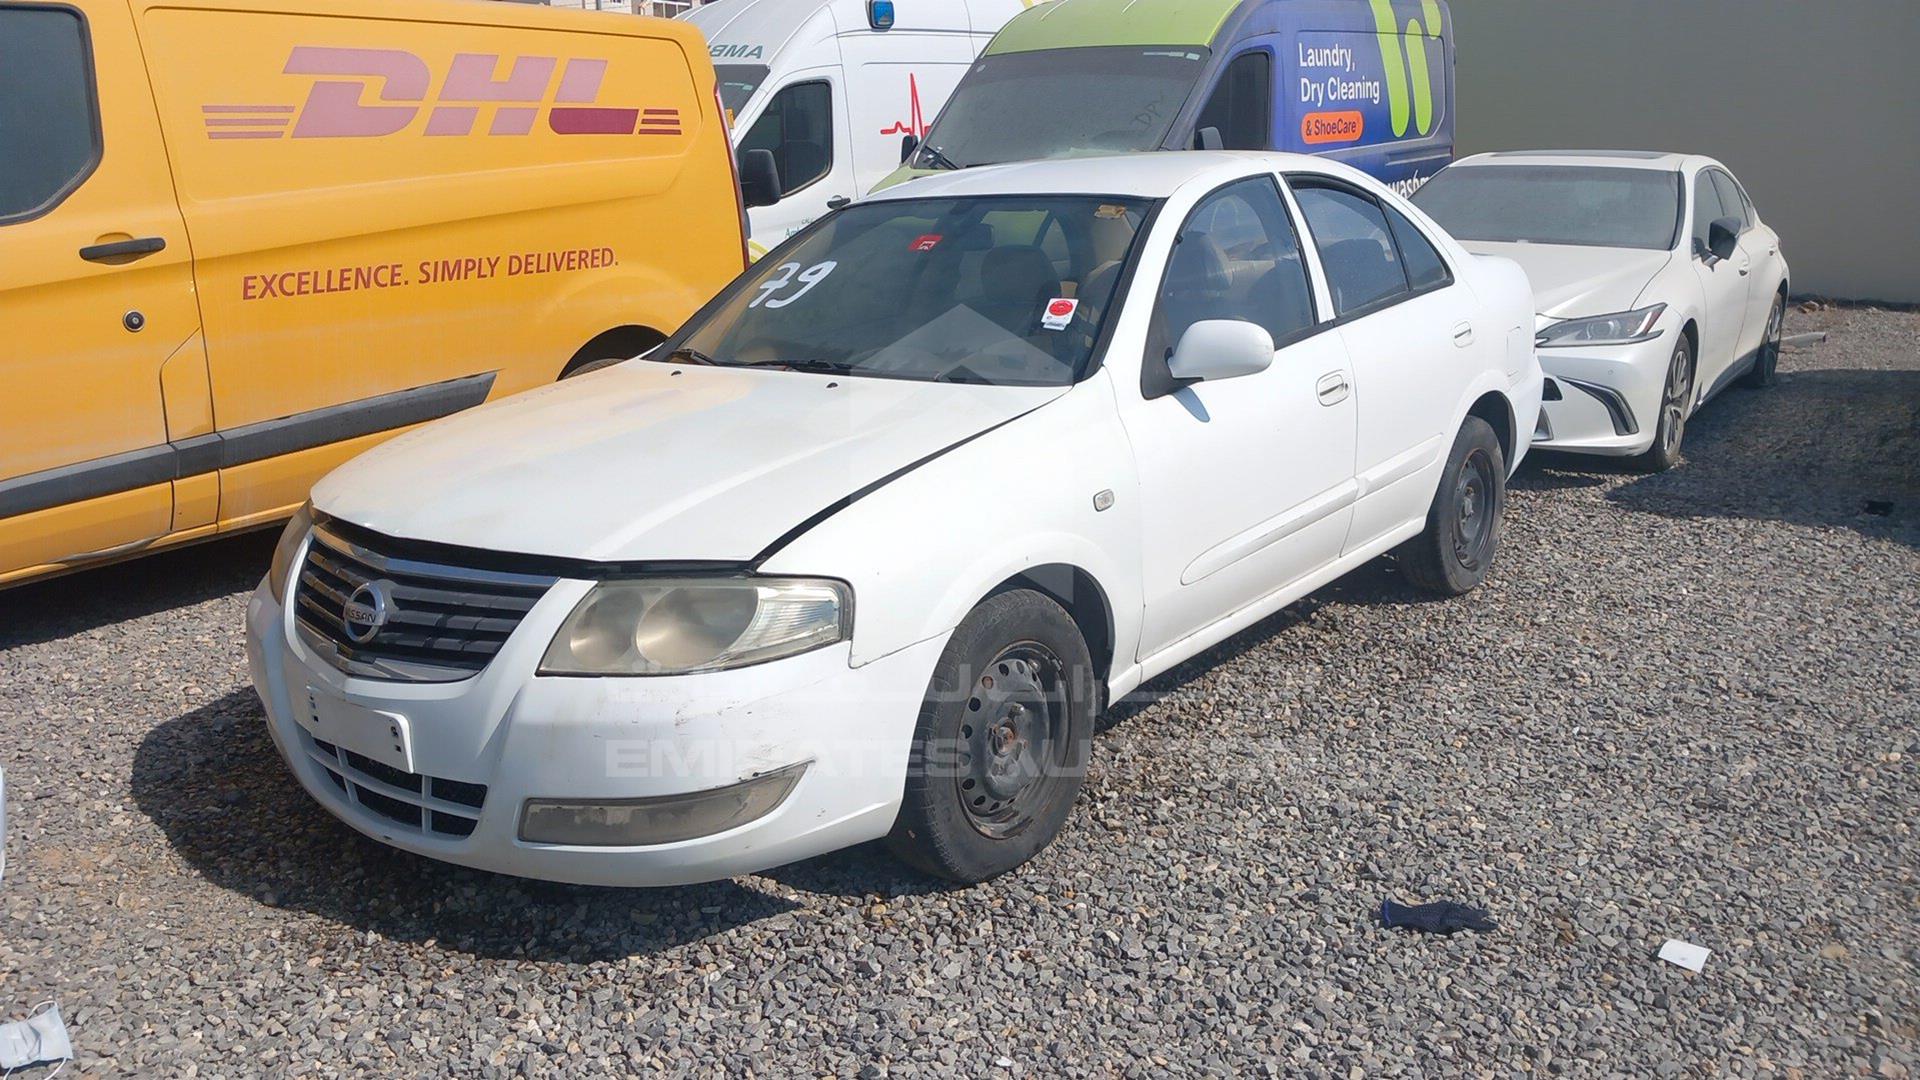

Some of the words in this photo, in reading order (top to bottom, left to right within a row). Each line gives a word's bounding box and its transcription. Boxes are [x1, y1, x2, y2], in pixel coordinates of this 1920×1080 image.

[1299, 43, 1356, 72] Laundry,
[283, 46, 640, 139] DHL
[1301, 78, 1324, 107] Dry
[1327, 76, 1380, 104] Cleaning
[1305, 120, 1313, 136] &
[1314, 119, 1357, 136] ShoeCare
[242, 263, 409, 300] EXCELLENCE.
[418, 256, 501, 284] SIMPLY
[507, 247, 620, 276] DELIVERED.
